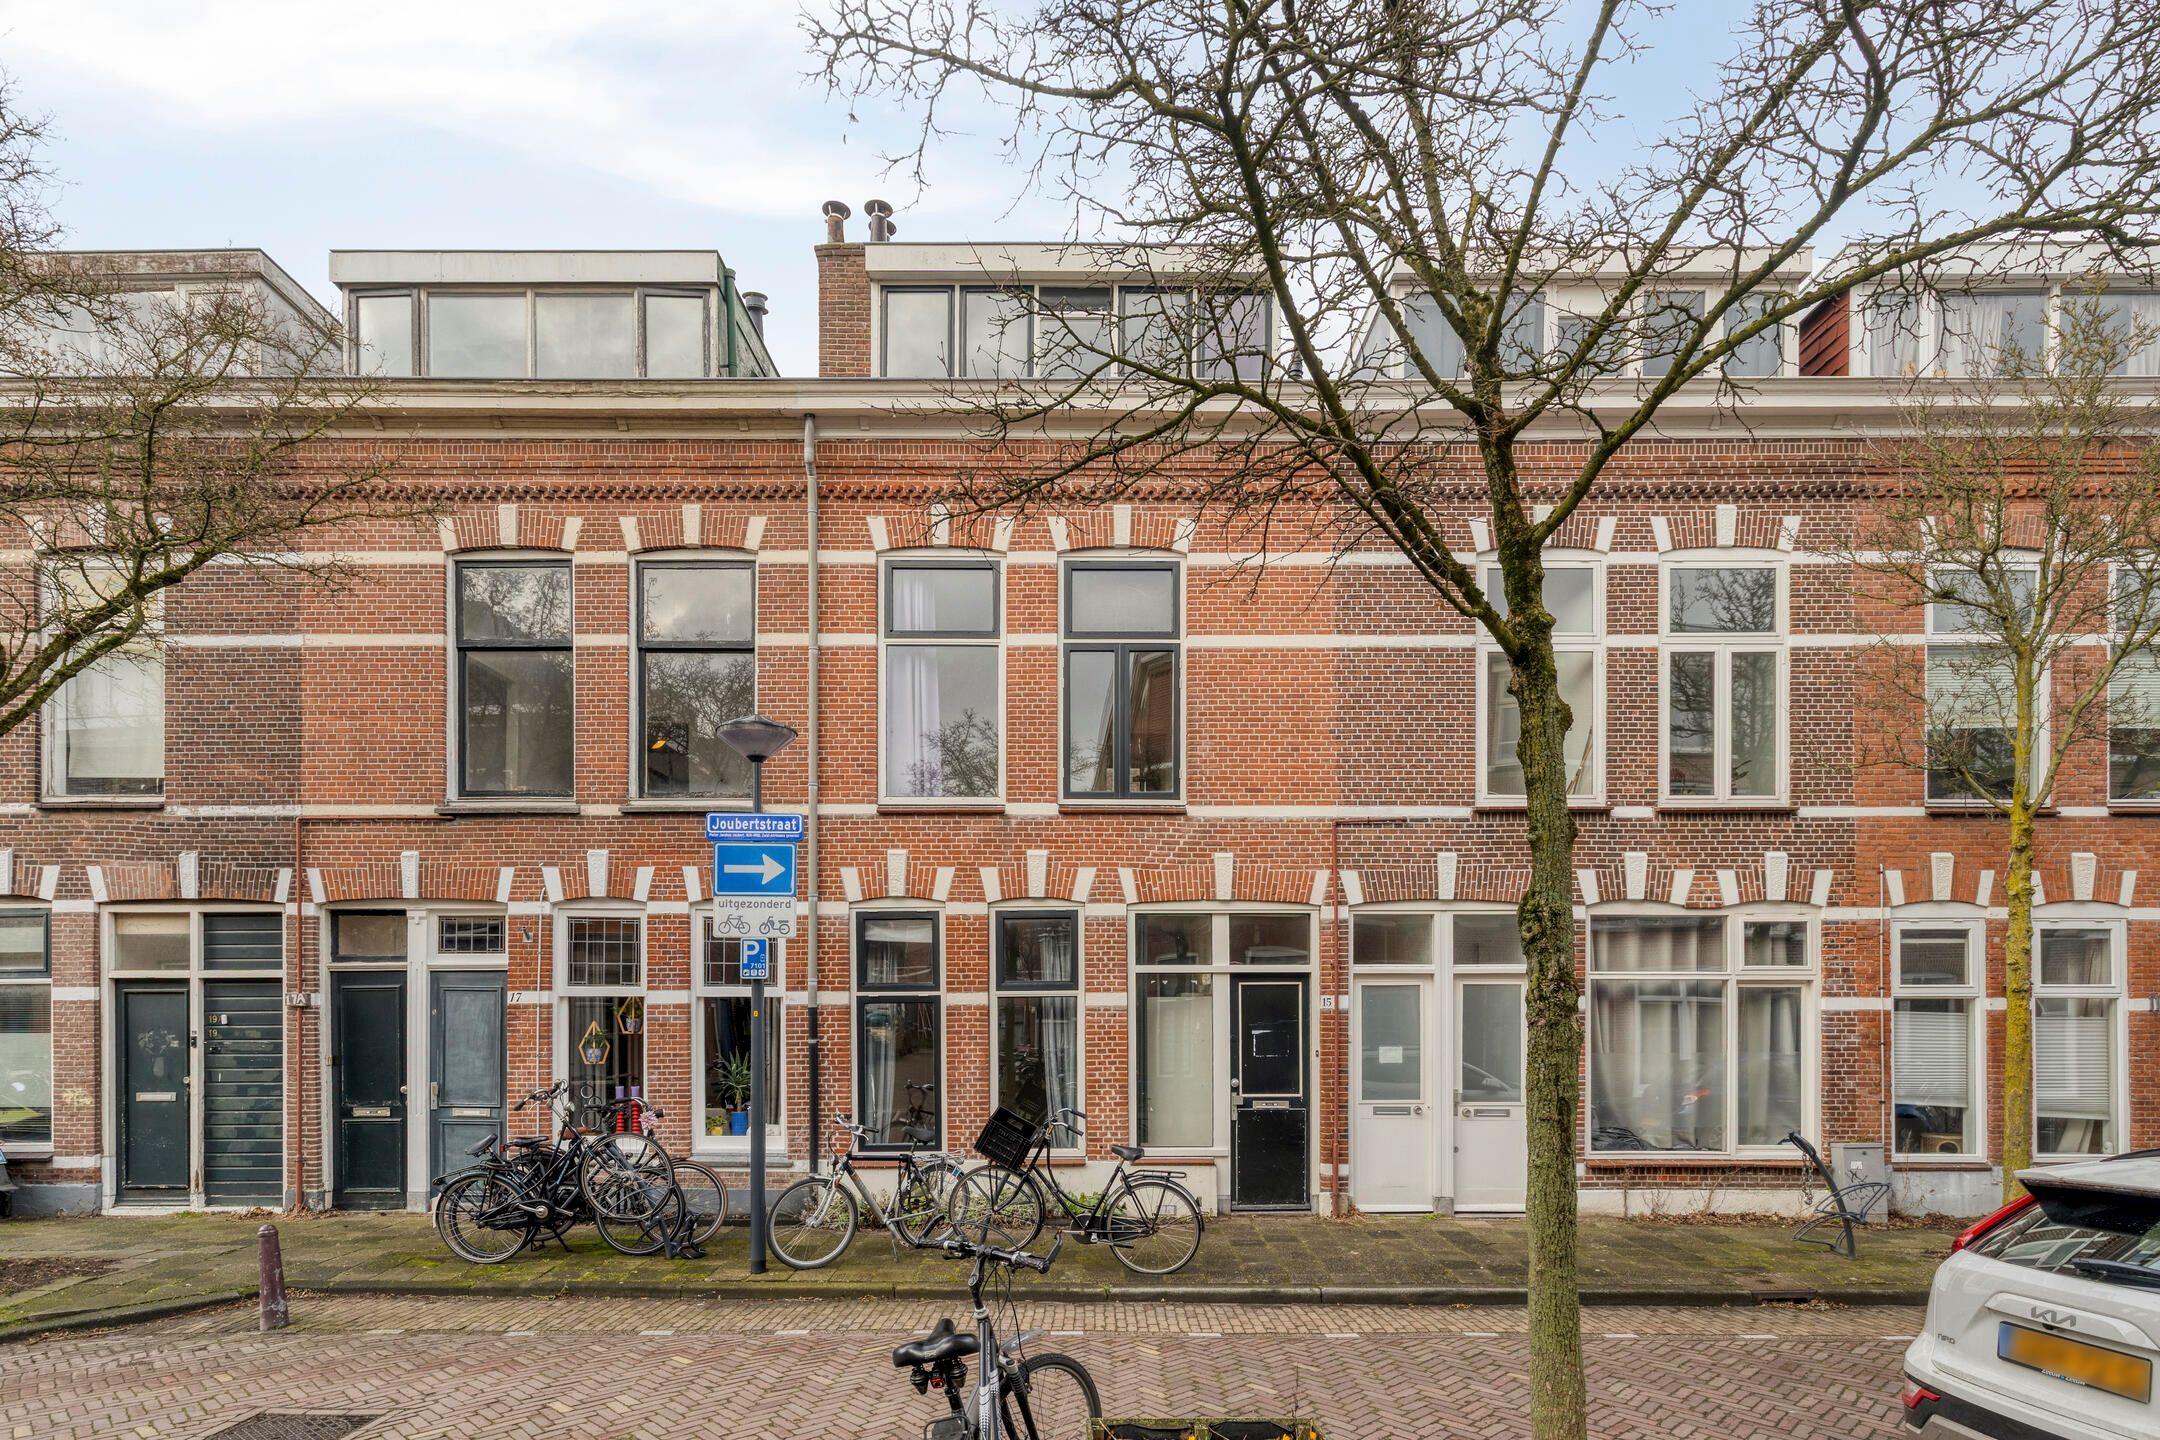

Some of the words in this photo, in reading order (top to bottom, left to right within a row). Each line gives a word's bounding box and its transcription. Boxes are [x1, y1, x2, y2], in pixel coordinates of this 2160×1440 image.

[712, 817, 797, 830] Joubertstraat
[718, 899, 792, 911] uitgezonderd
[743, 940, 760, 964] P
[285, 993, 306, 1006] 17A
[510, 992, 522, 1003] 17
[1322, 997, 1332, 1007] 15
[208, 1028, 218, 1038] 19
